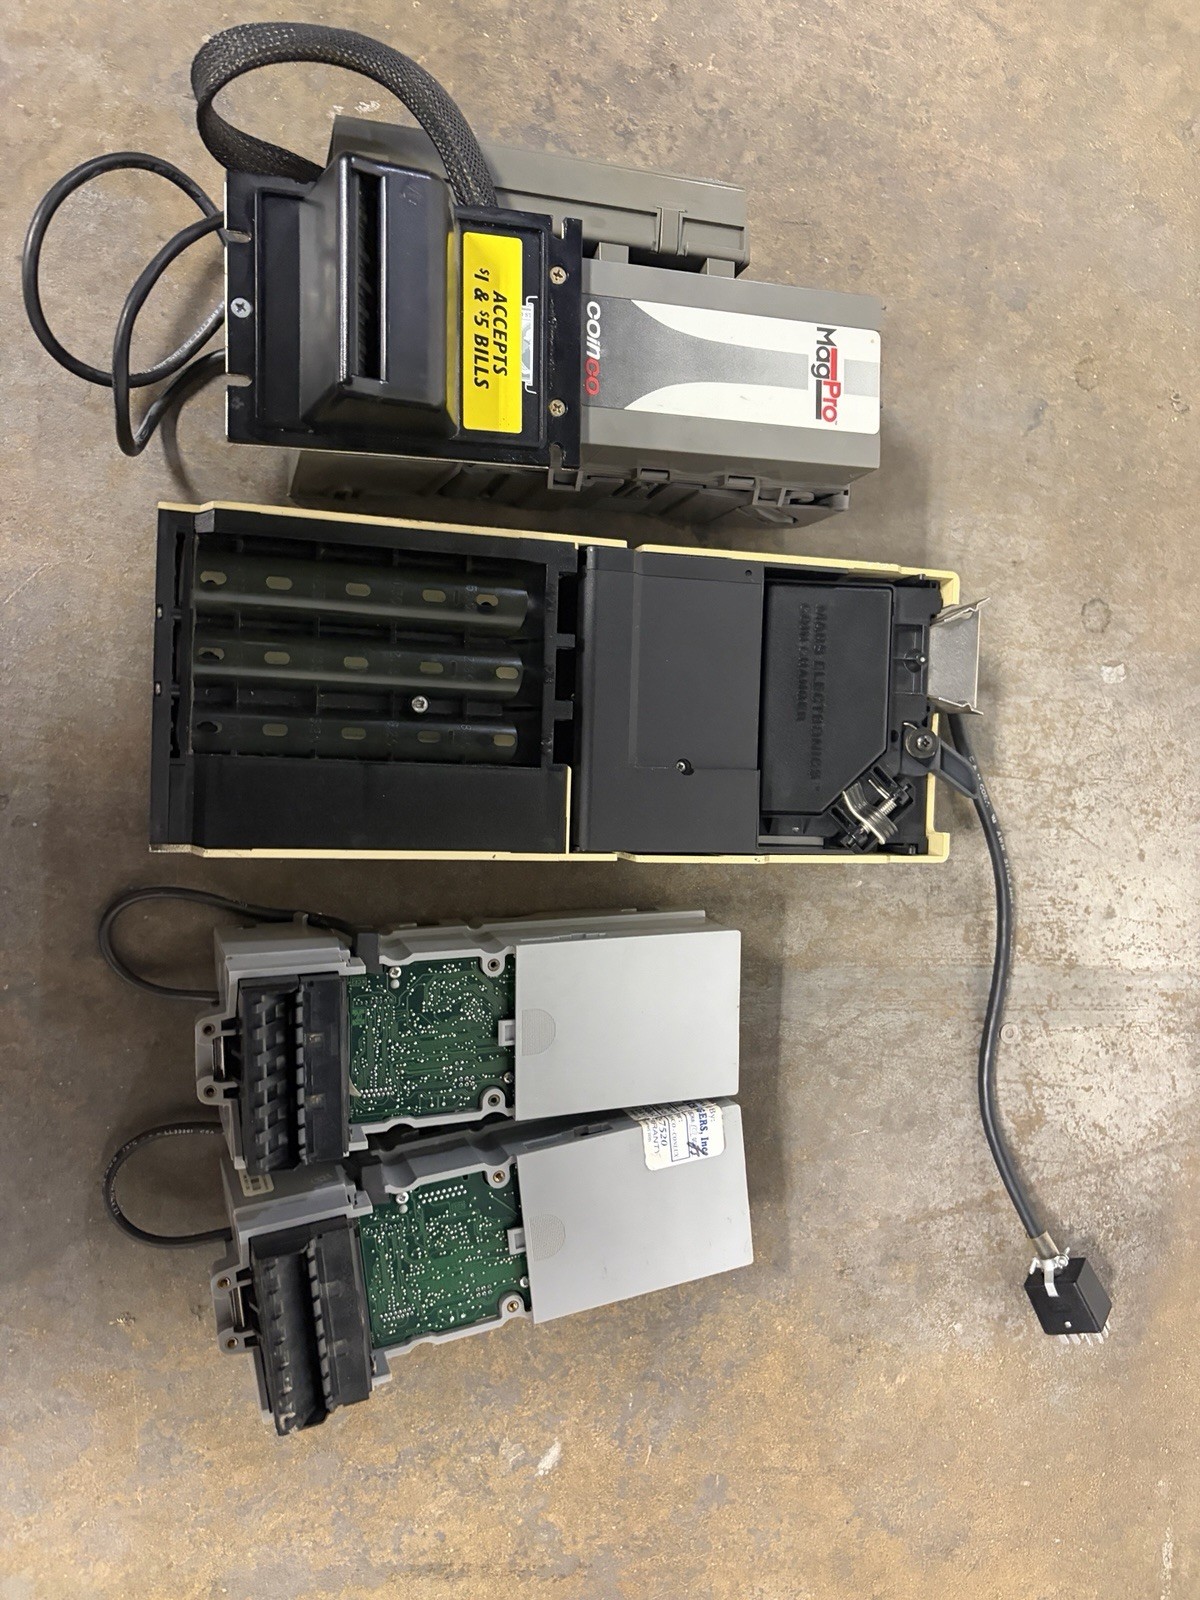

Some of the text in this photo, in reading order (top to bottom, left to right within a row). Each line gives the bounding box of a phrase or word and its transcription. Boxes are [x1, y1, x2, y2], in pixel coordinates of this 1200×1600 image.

[473, 268, 490, 390] $1 & $5 BILLS
[492, 290, 507, 376] ACCEPTS
